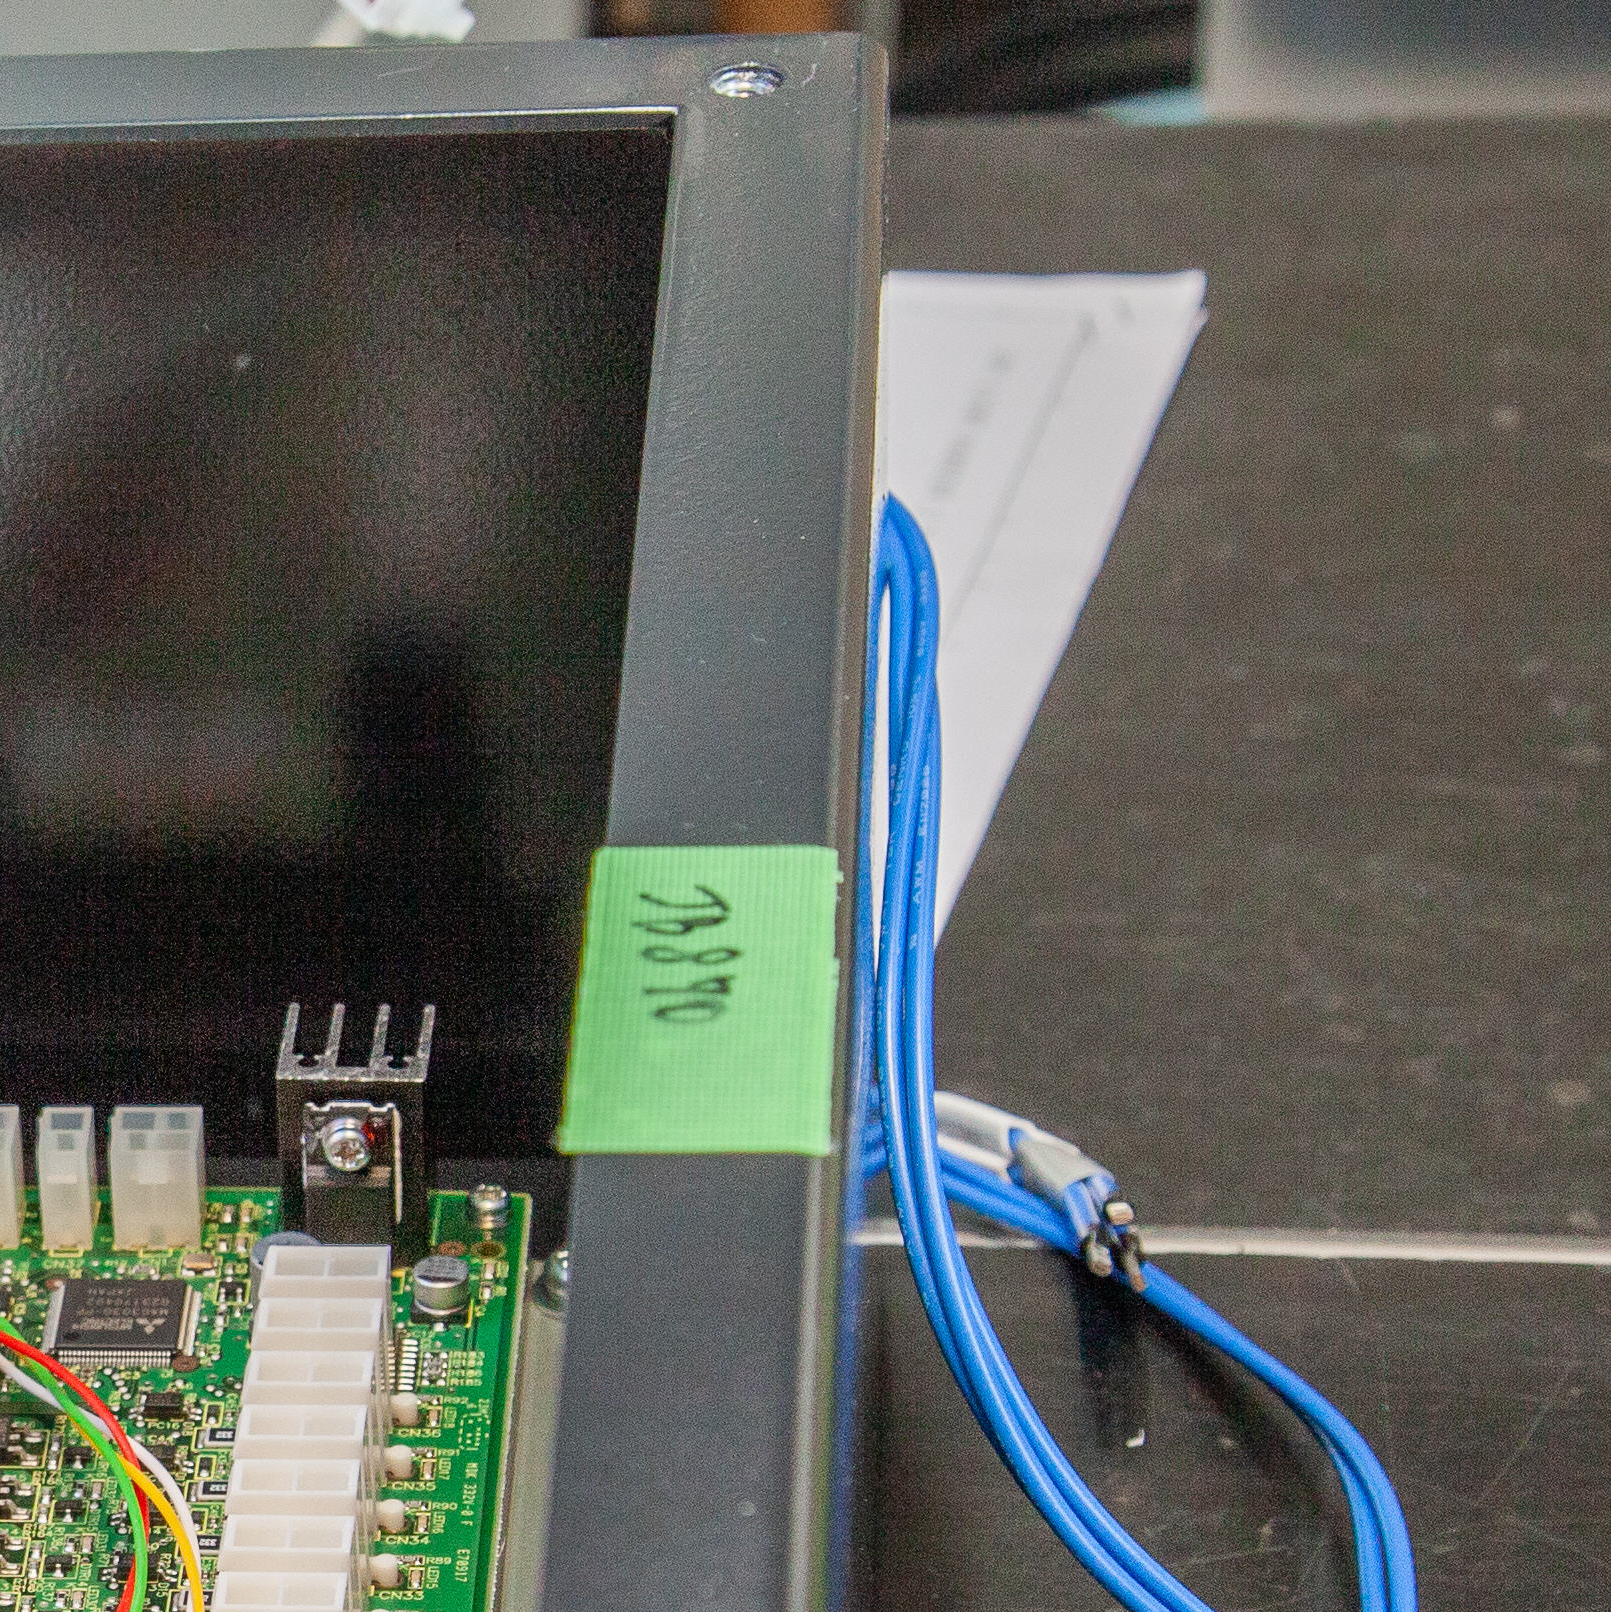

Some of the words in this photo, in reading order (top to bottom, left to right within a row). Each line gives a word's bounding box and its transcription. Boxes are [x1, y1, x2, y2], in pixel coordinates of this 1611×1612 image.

[398, 1429, 441, 1438] CN36
[392, 1481, 436, 1490] CN35
[385, 1535, 430, 1545] CN34
[379, 1591, 424, 1600] CN33
